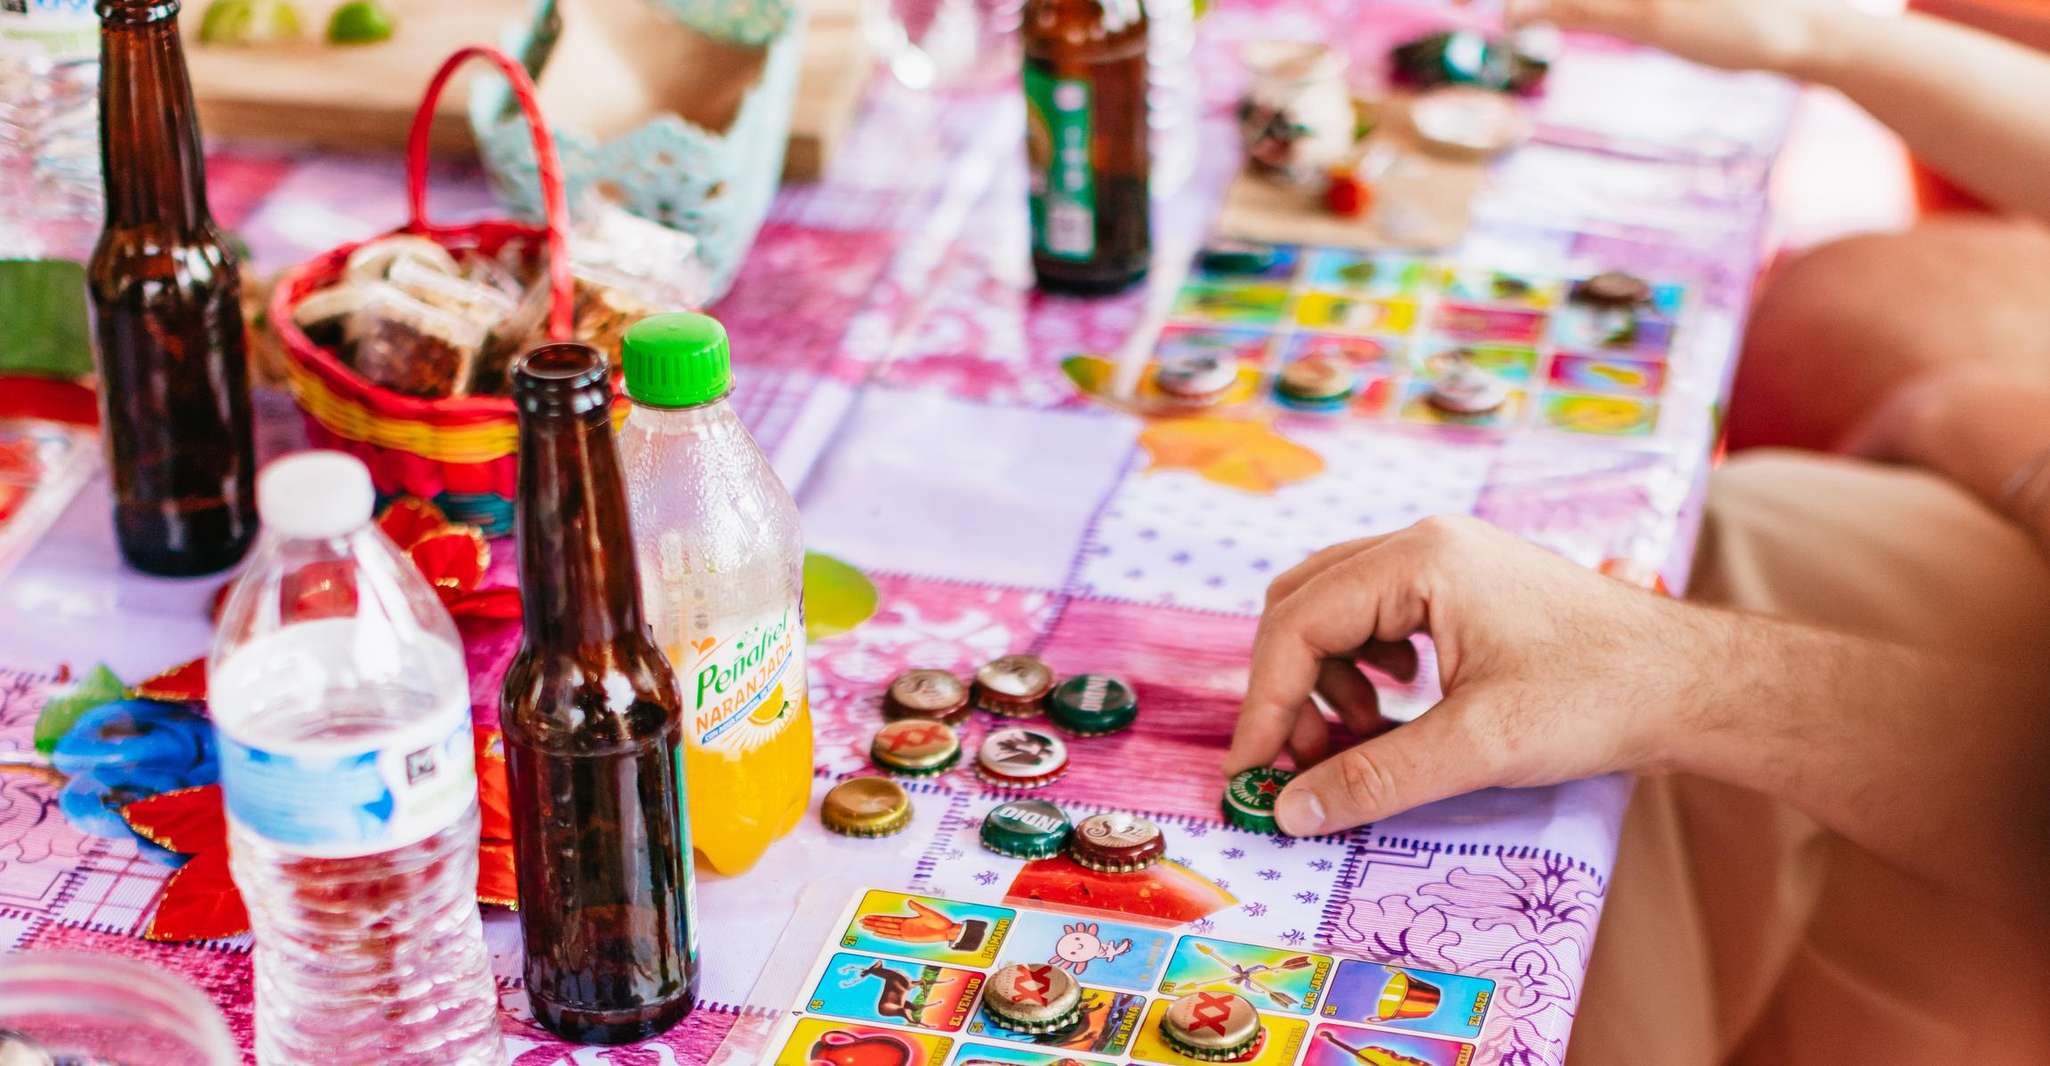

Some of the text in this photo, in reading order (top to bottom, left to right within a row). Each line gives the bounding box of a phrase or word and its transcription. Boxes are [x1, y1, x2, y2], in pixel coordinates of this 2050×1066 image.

[696, 633, 792, 736] NARANJADA
[998, 806, 1065, 833] INDIO
[949, 978, 981, 1028] EL VENADO
[1302, 961, 1330, 1009] LAS JARAS
[1120, 1007, 1140, 1031] RANA
[1468, 991, 1490, 1027] EL CAZO
[1114, 1033, 1129, 1047] LA
